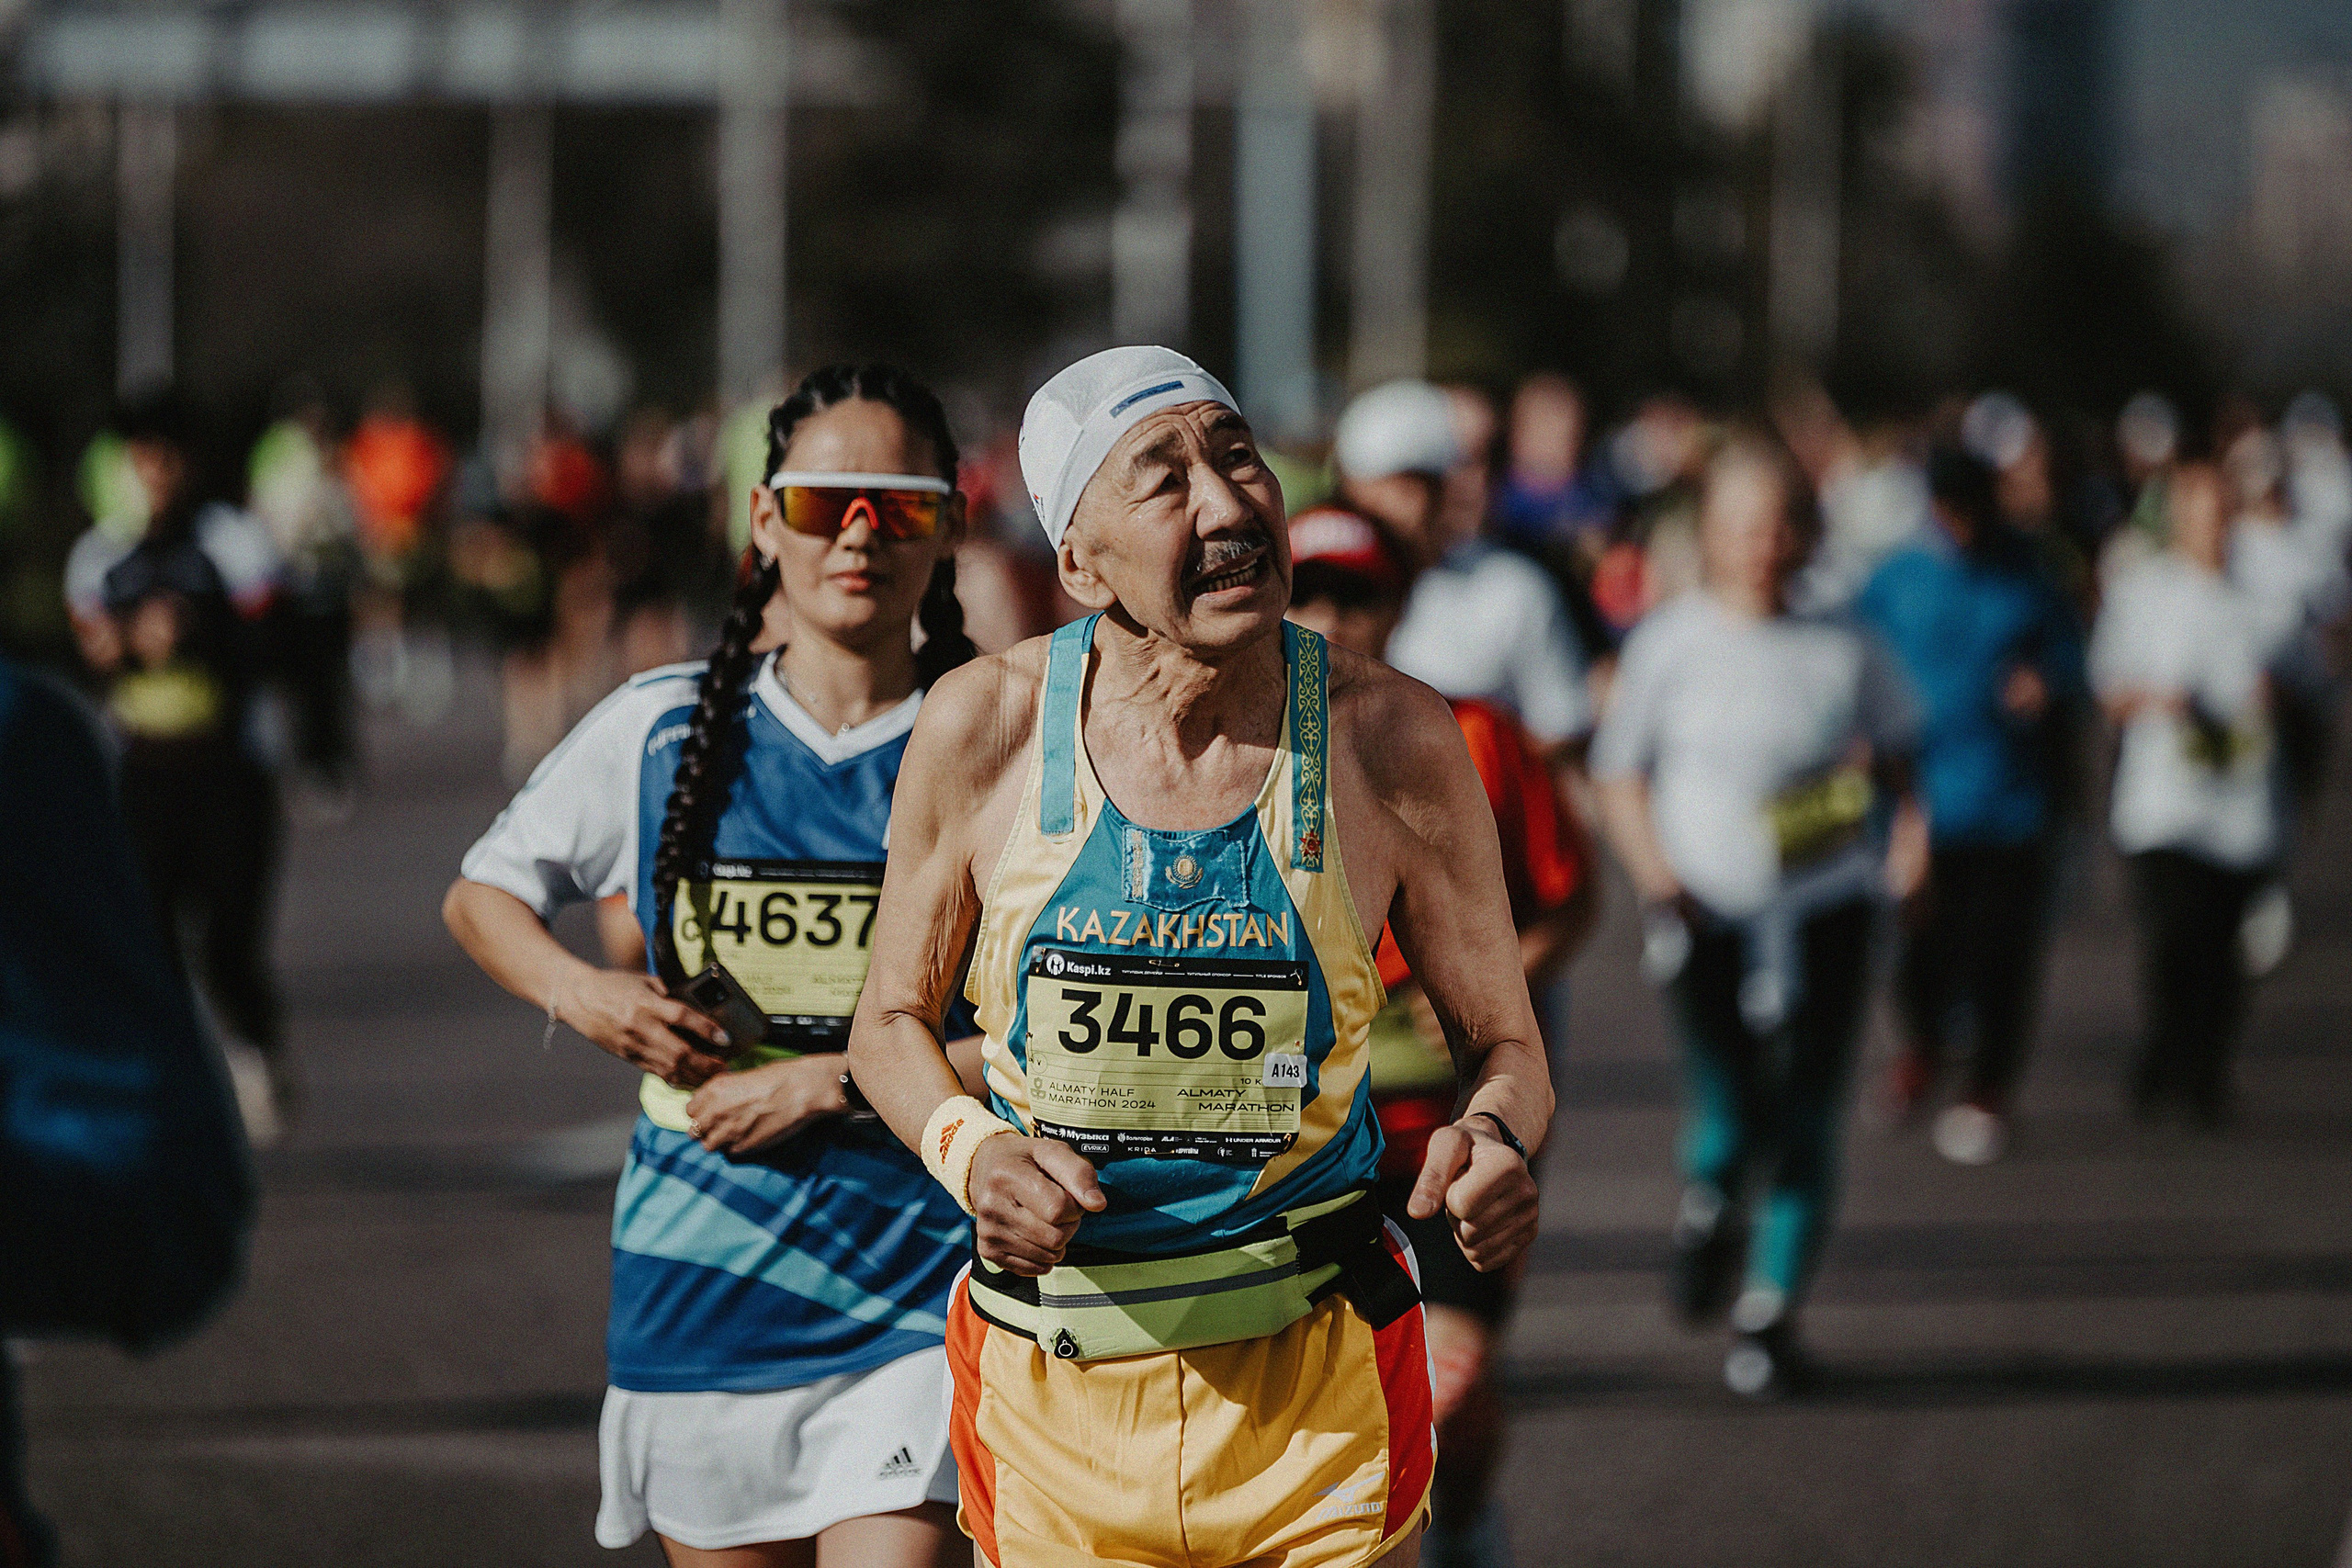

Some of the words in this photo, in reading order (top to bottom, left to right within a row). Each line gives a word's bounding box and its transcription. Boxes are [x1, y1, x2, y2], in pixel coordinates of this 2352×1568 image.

[710, 891, 880, 947] 4637
[1057, 907, 1288, 949] KAZAKHSTAN
[1067, 961, 1112, 976] Kaspi.kz
[1058, 988, 1267, 1061] 3466
[1272, 1063, 1300, 1078] A143
[1049, 1082, 1096, 1095] ALMATY
[1101, 1088, 1136, 1097] HALF
[1177, 1089, 1247, 1098] ALMATY
[1048, 1093, 1116, 1108] MARATHON
[1122, 1100, 1156, 1109] 2024
[1198, 1102, 1295, 1112] MARATHON
[1067, 1129, 1110, 1141] Музыка
[1316, 1502, 1383, 1521] MIZUNO
